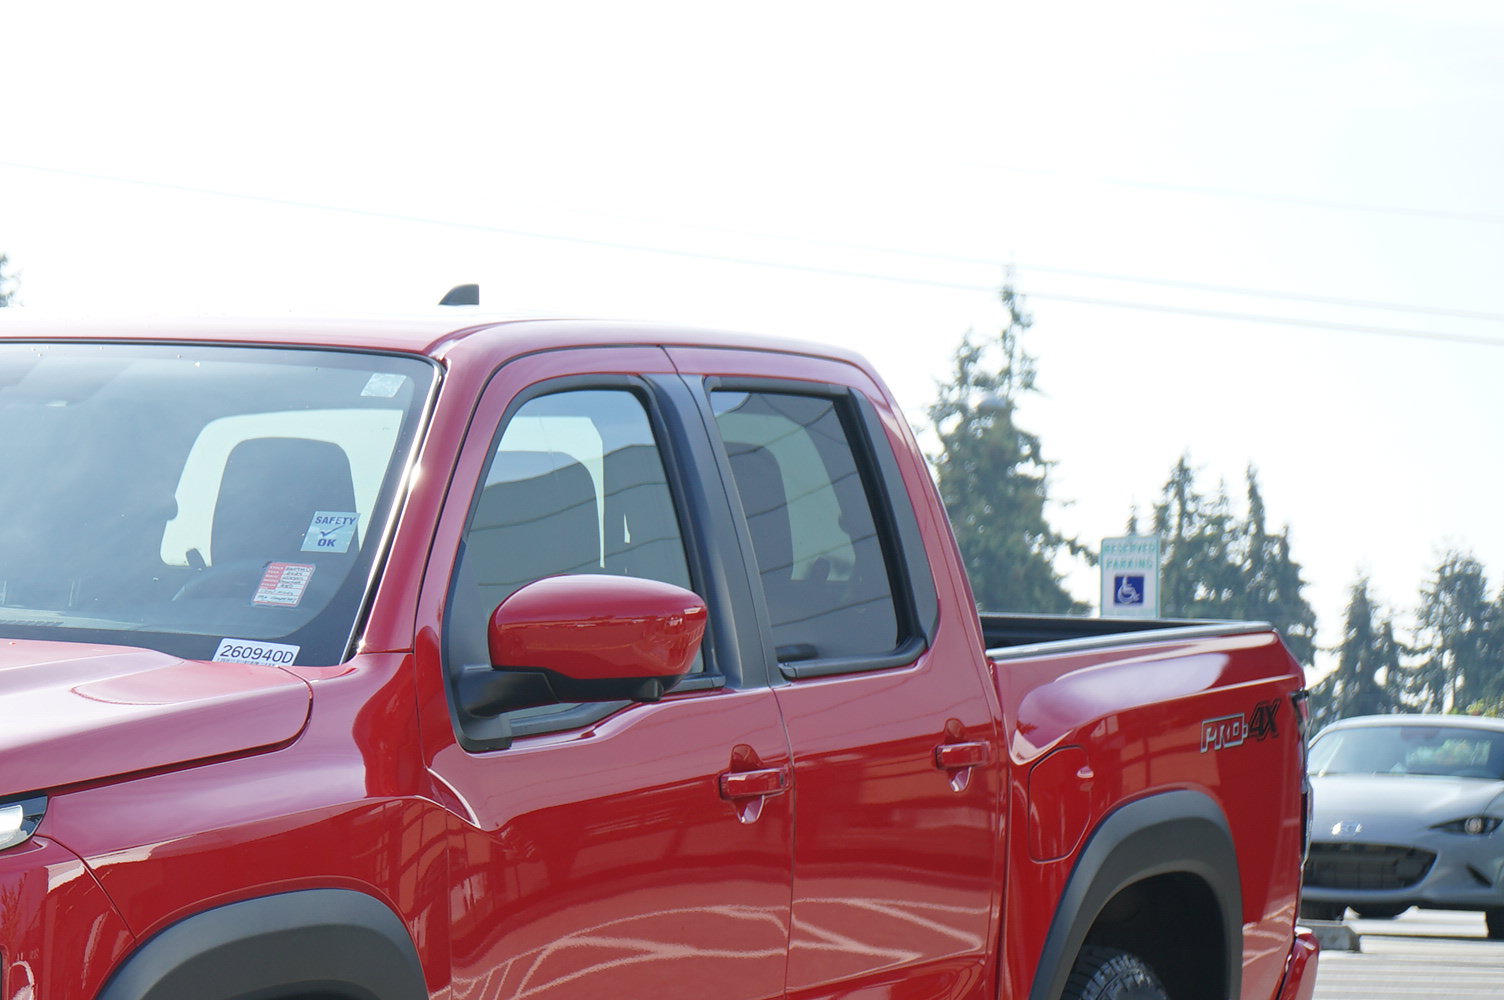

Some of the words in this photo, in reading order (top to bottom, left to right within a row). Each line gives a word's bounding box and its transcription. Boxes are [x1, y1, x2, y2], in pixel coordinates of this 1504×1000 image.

[314, 515, 357, 526] SAFETY
[318, 538, 337, 548] OK
[219, 644, 295, 664] 260940D
